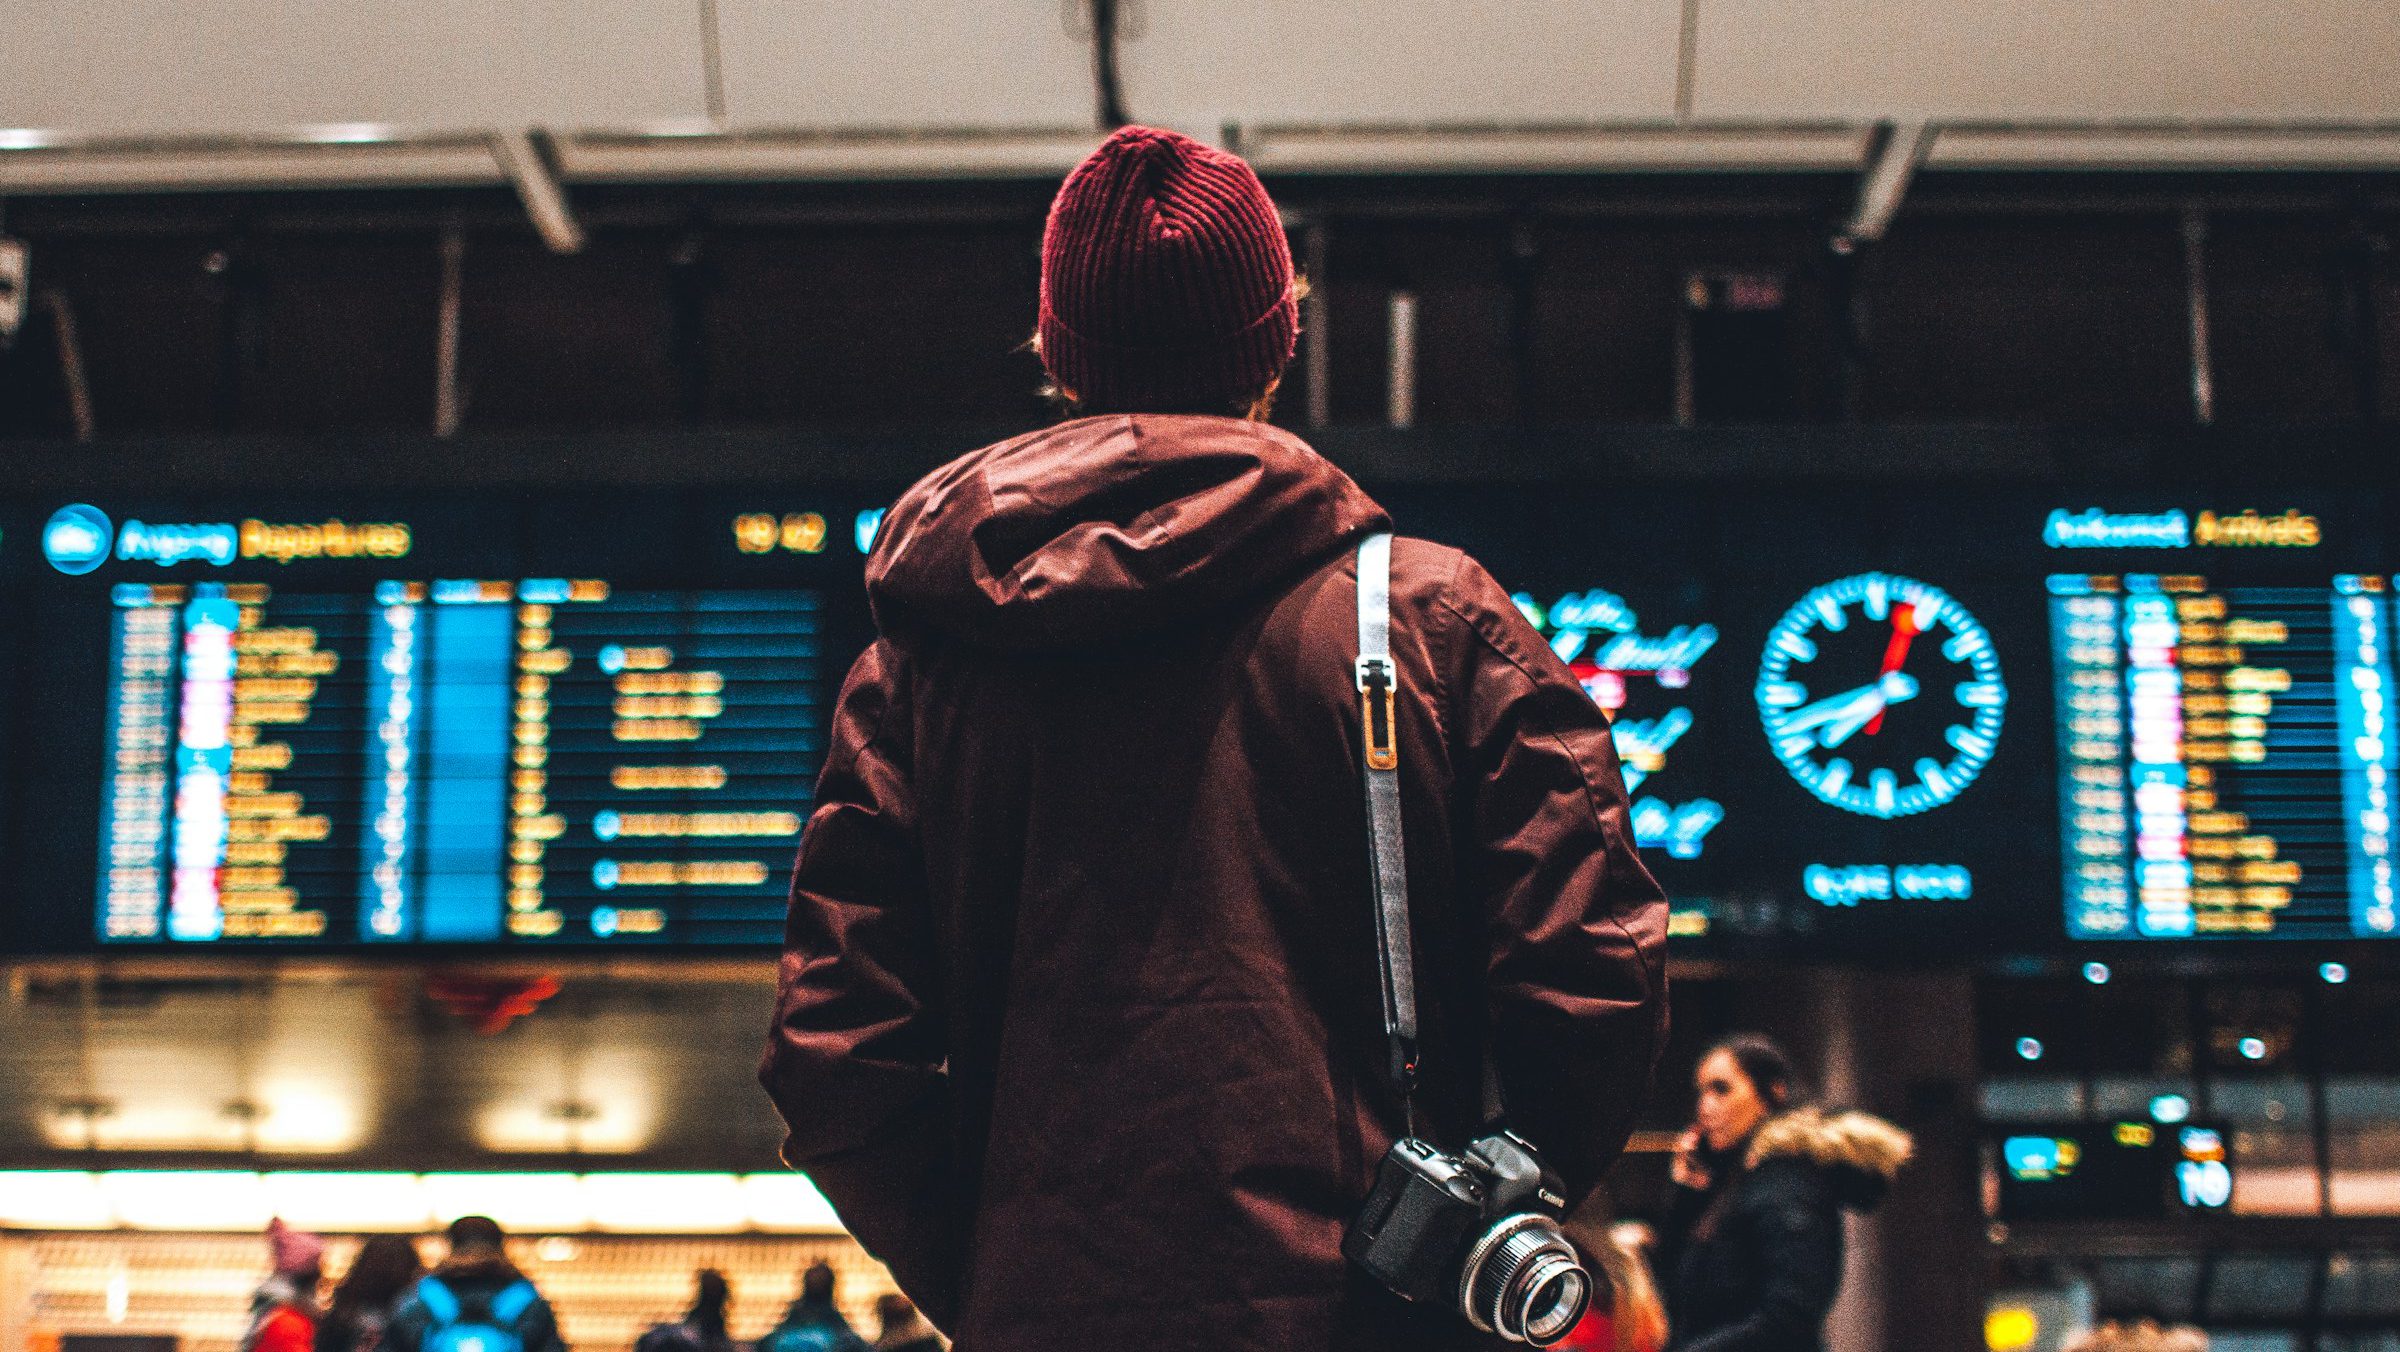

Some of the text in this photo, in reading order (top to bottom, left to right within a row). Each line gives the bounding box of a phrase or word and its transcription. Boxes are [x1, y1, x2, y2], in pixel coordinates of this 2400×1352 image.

[117, 519, 411, 565] Avgang Departures
[2196, 509, 2321, 547] Arrivals
